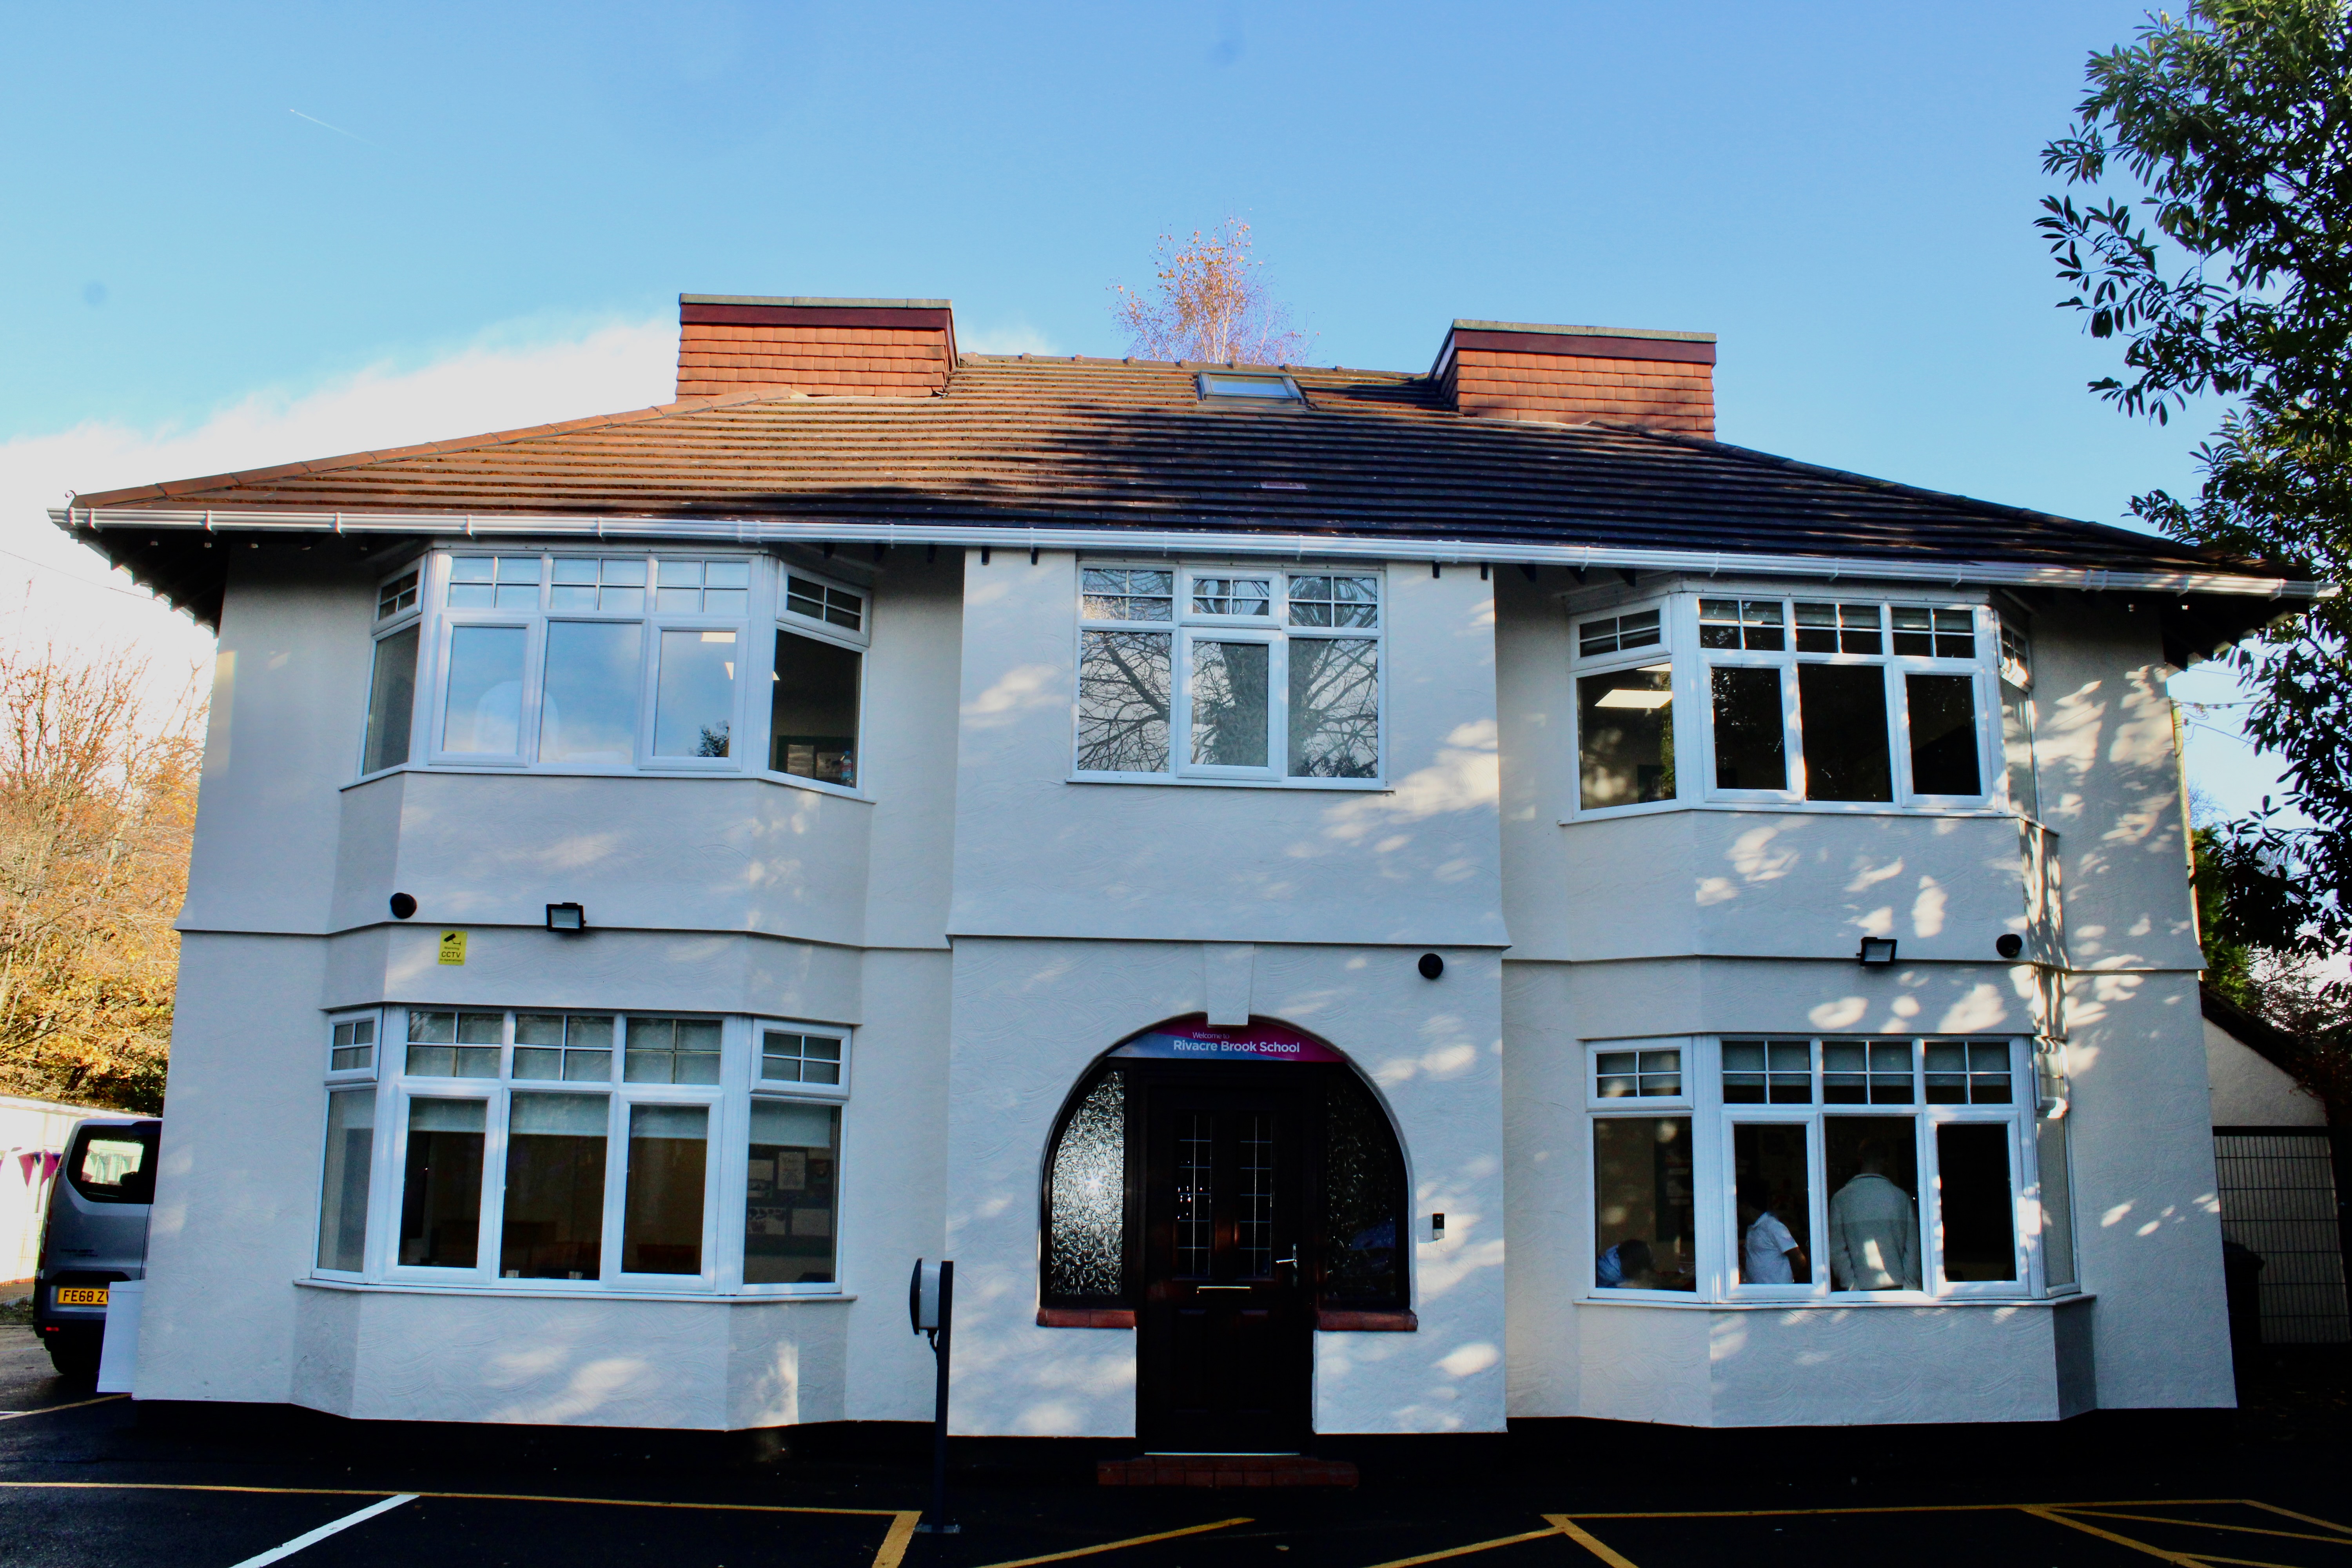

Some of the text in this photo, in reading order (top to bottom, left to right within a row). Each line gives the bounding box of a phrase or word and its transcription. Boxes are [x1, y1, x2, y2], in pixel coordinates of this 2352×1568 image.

[1174, 1040, 1300, 1053] Rivacre Brook School
[64, 1290, 94, 1302] FE68
